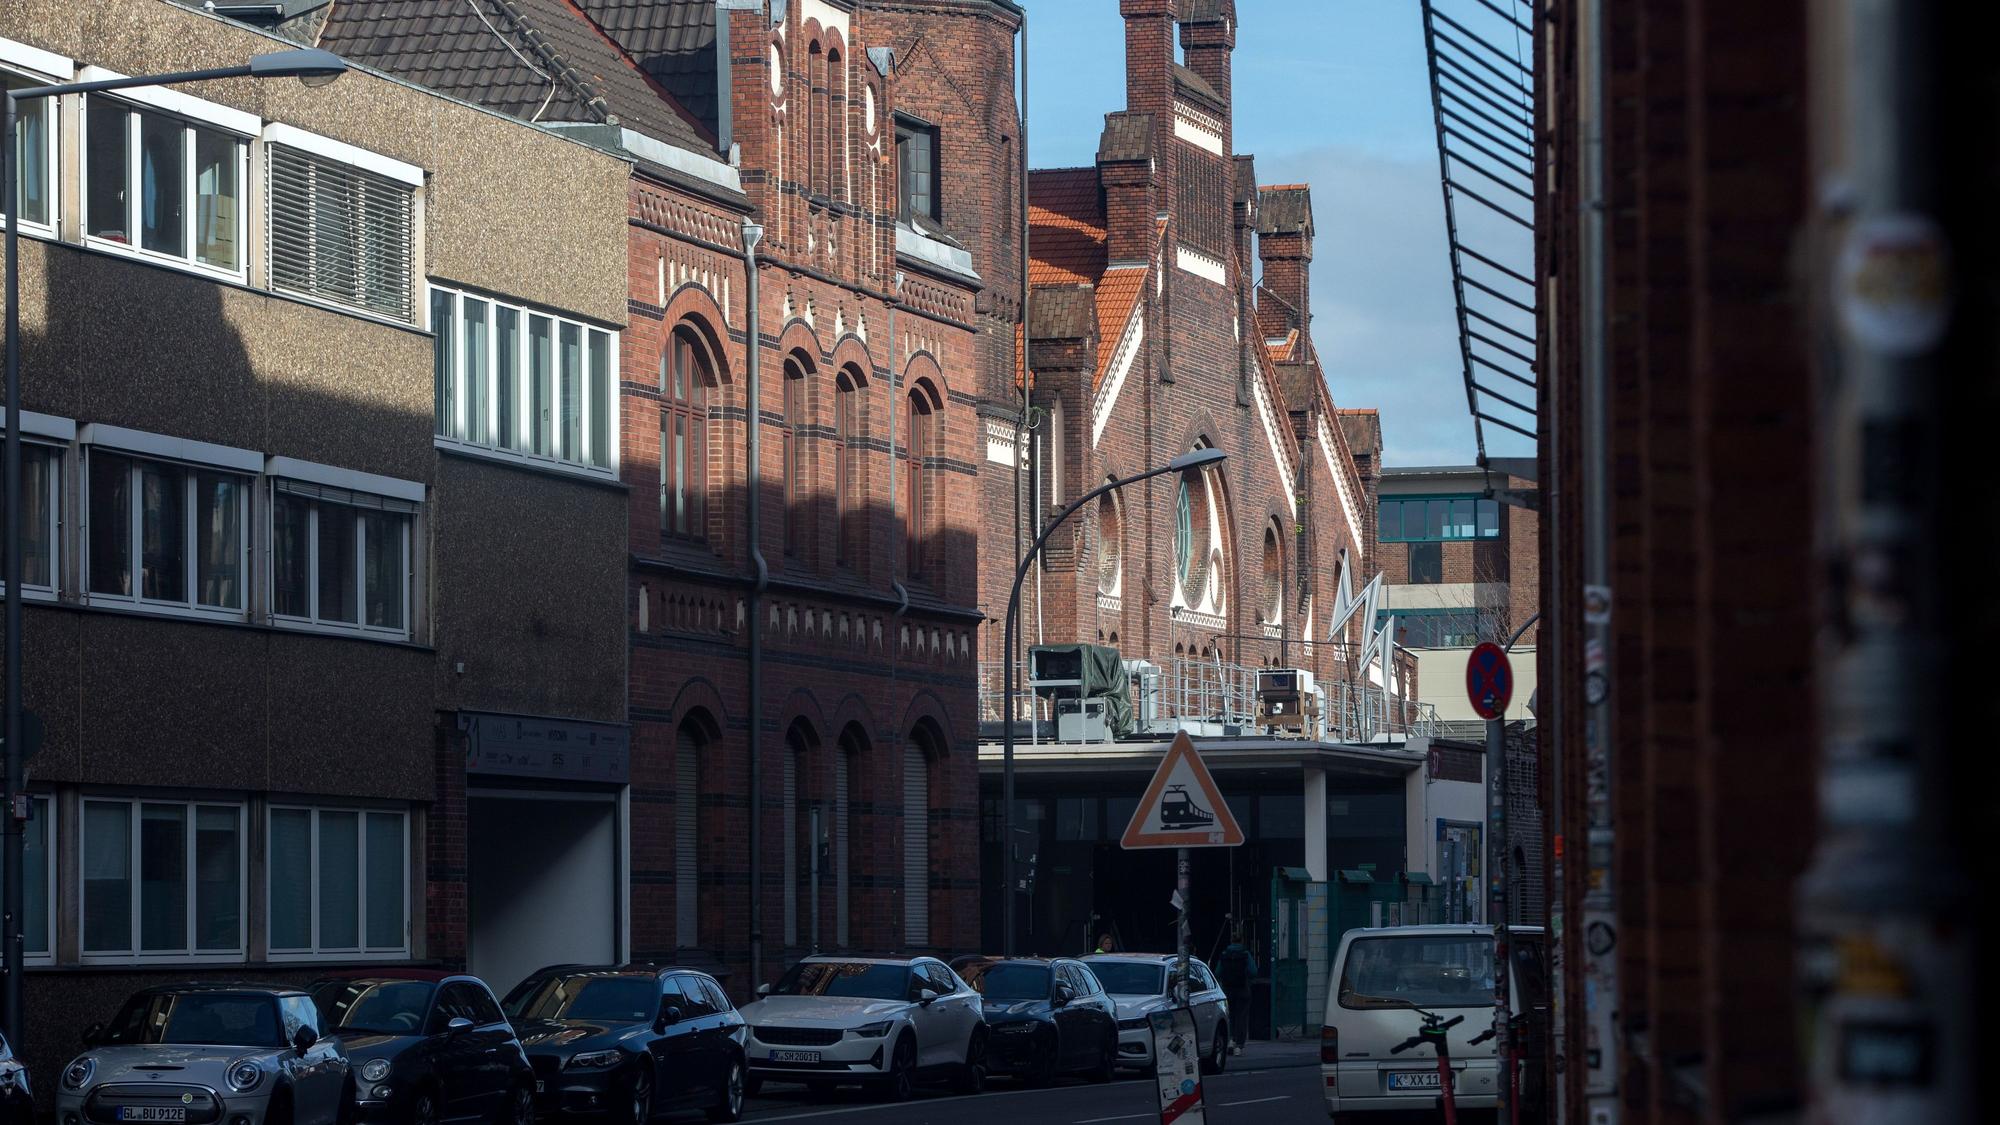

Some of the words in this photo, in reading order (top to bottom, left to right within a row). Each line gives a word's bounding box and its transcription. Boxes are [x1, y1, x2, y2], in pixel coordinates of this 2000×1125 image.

[1396, 1075, 1402, 1086] K
[1410, 1075, 1423, 1086] XX
[123, 1107, 136, 1119] GL
[143, 1108, 156, 1120] BU
[158, 1108, 184, 1120] 912E
